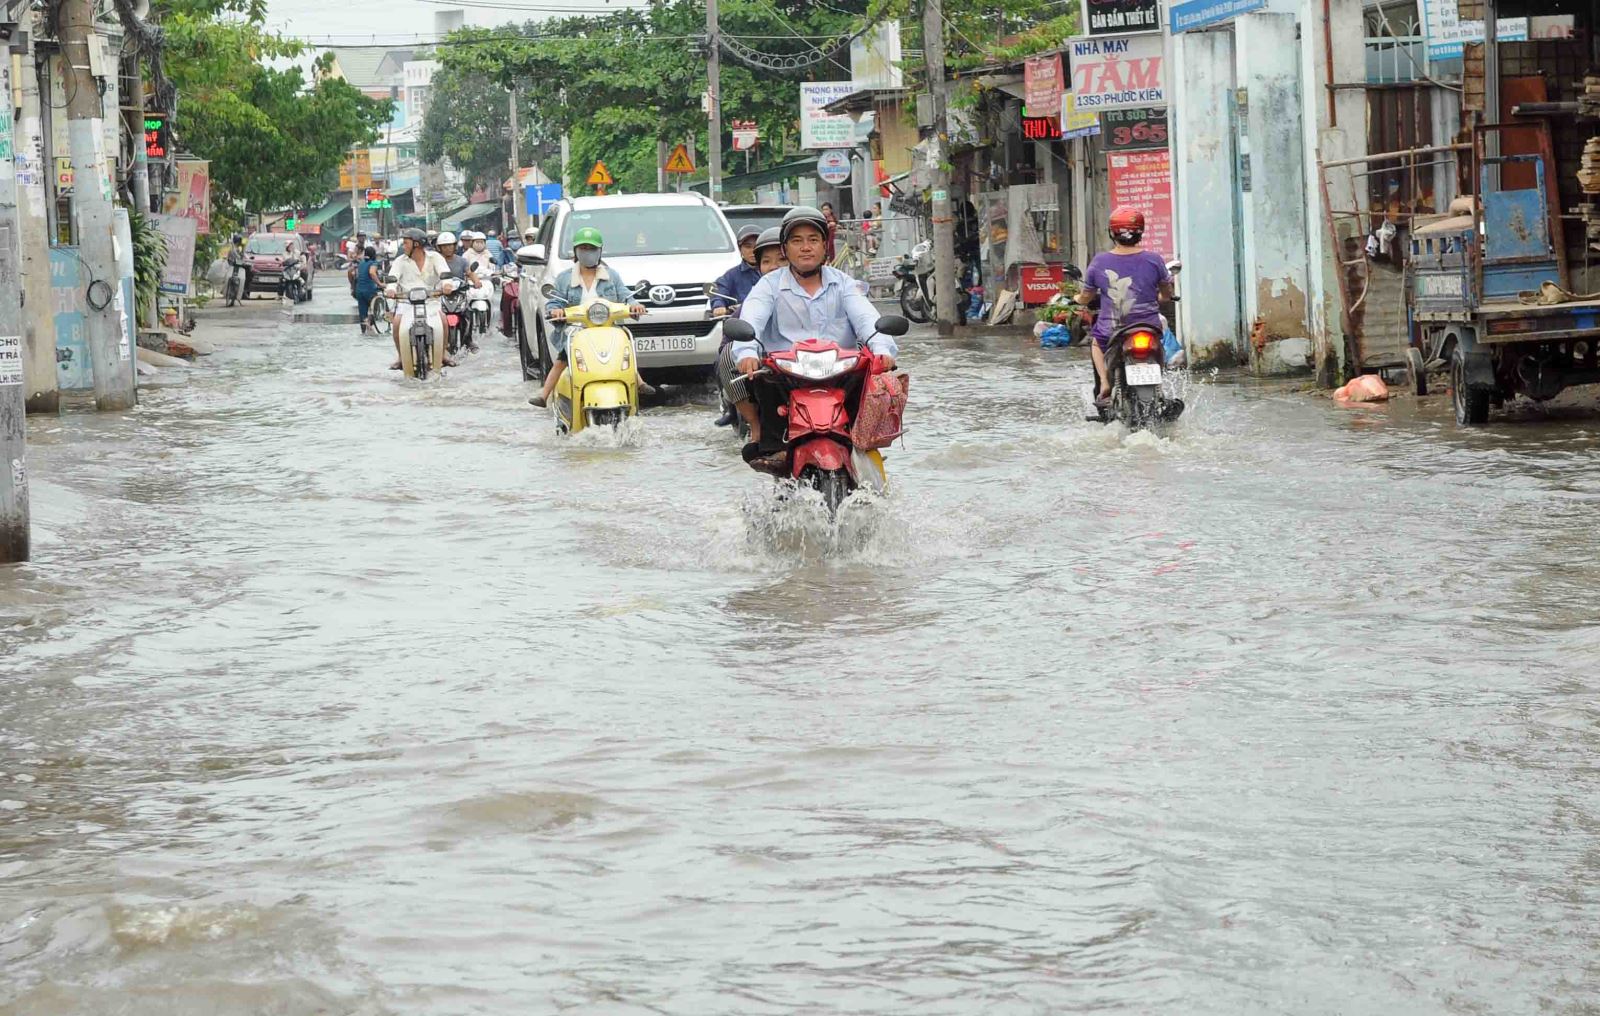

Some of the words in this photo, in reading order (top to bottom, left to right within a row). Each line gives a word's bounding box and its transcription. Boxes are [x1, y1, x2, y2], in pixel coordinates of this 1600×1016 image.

[1075, 39, 1100, 56] NHÀ
[1103, 39, 1129, 54] MAY
[1113, 121, 1168, 145] 365
[1026, 283, 1059, 291] VISSAN
